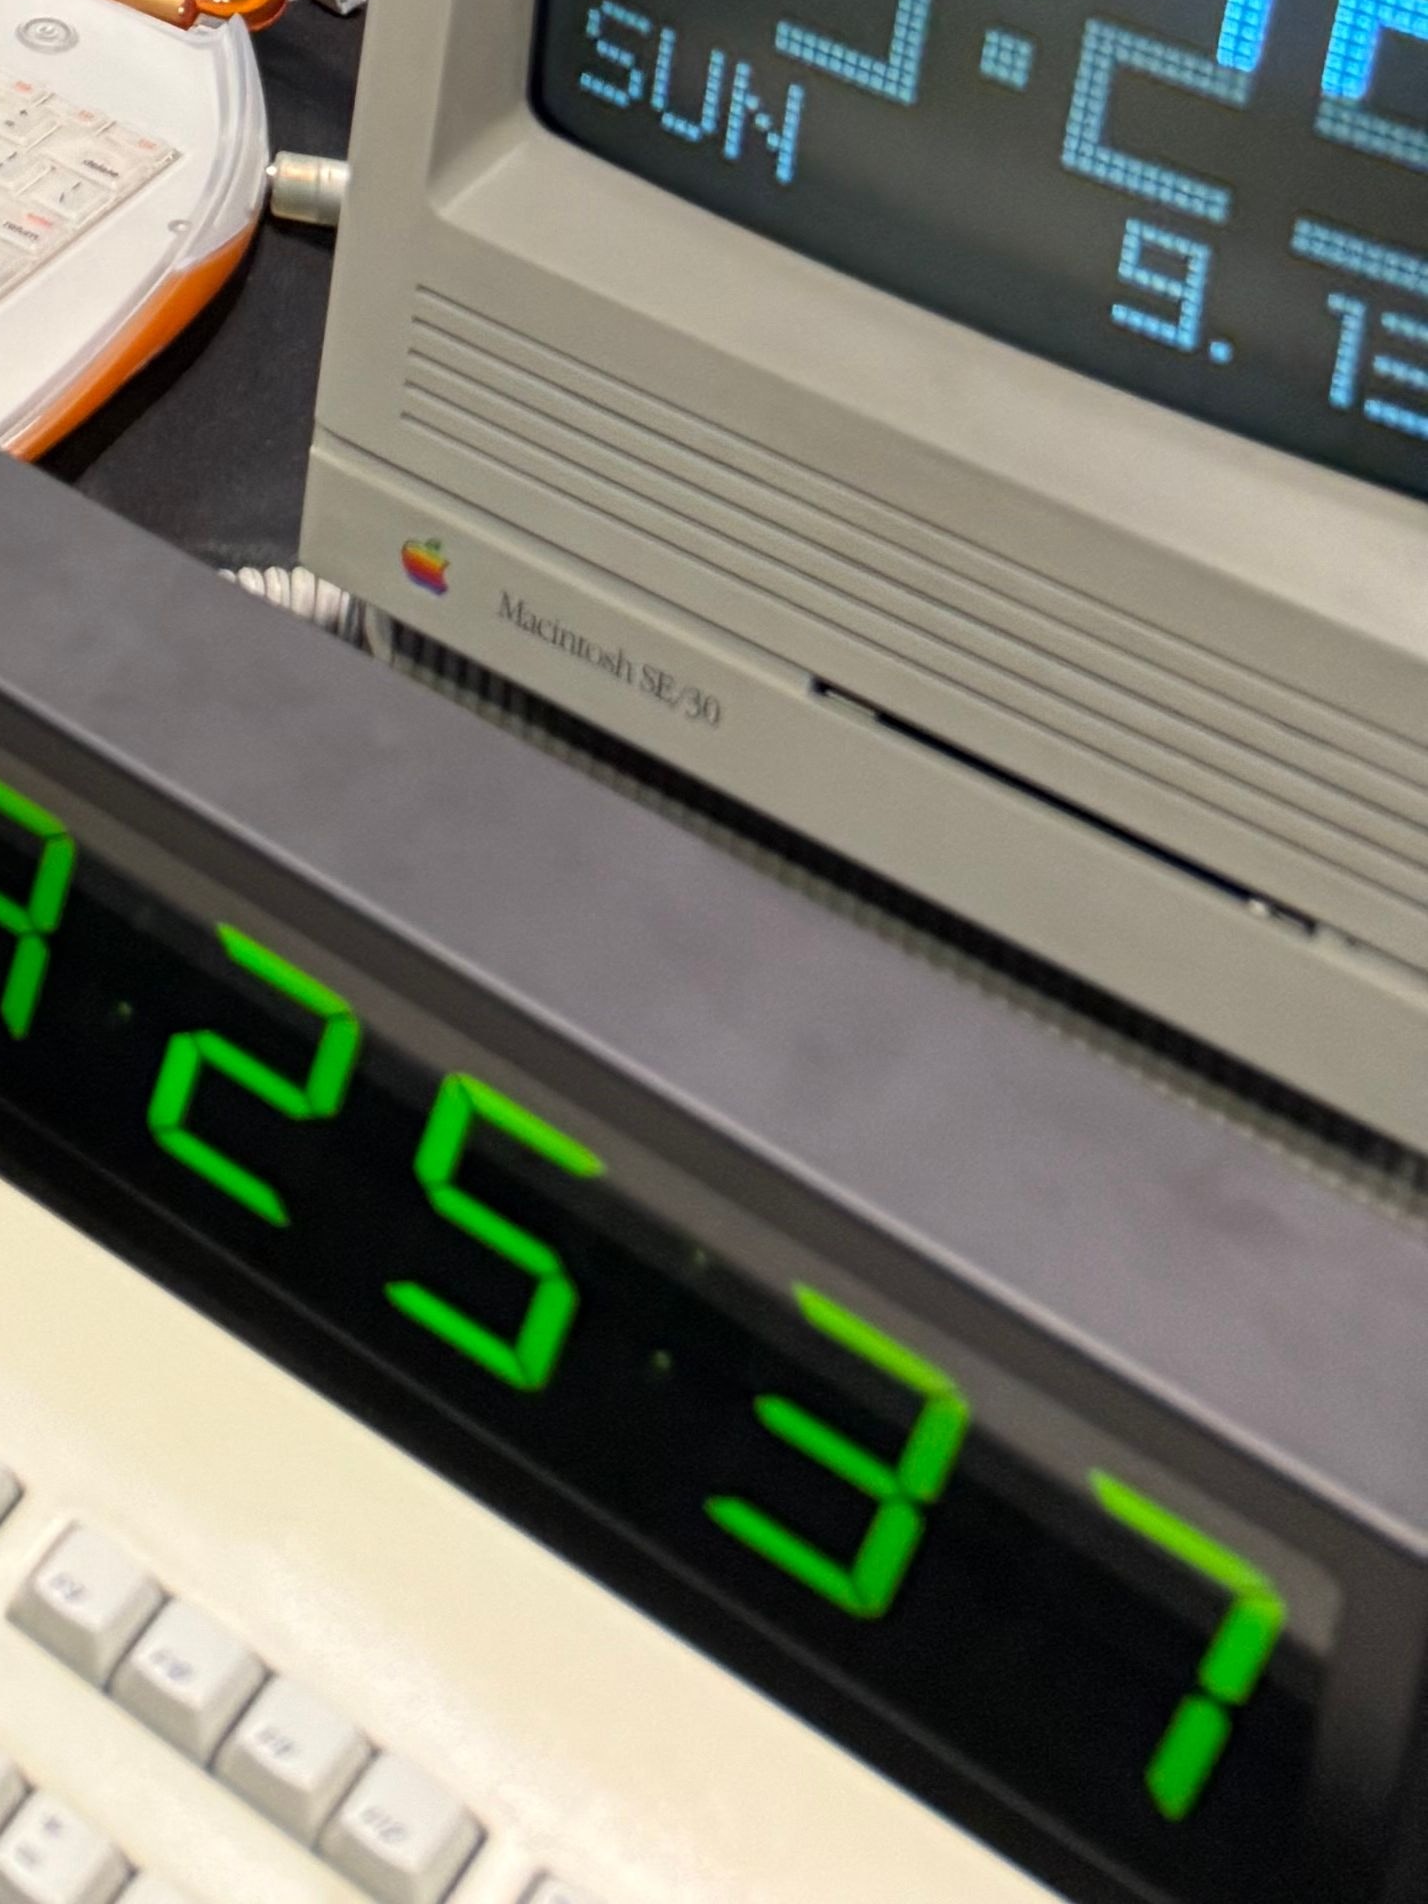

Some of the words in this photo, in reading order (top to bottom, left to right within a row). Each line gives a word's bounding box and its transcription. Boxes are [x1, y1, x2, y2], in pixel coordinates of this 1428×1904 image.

[579, 0, 804, 184] SUN
[498, 590, 633, 684] Macintosh
[640, 663, 722, 728] SE/30
